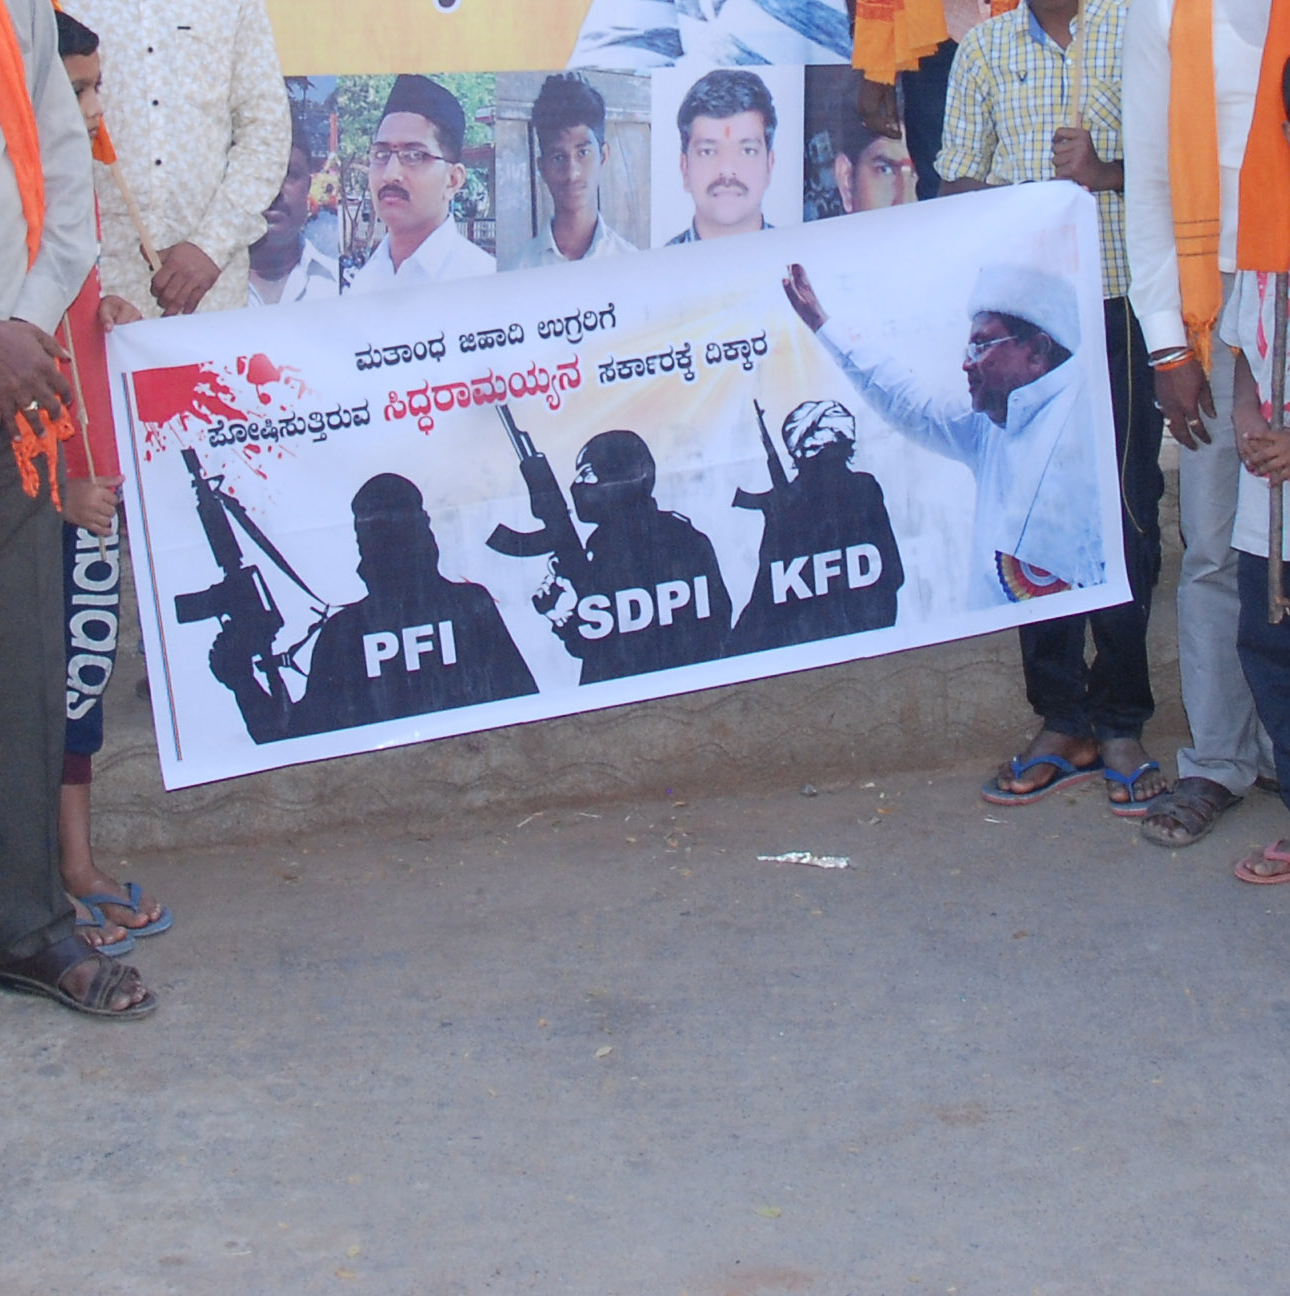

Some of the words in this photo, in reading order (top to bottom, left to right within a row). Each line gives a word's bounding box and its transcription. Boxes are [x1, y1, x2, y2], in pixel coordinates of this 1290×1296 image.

[355, 331, 446, 371] ಮತಾಂಧ
[459, 322, 524, 354] ಜಿಹಾದಿ
[538, 303, 616, 344] ಉಗ್ರರಿಗೆ
[208, 399, 370, 448] ಪೋಷಿಸುತ್ತಿರುವ
[383, 353, 582, 435] ಸಿದ್ಧರಾಮಯ್ಯನ
[598, 342, 694, 383] ಸರ್ಕಾರಕ್ಕೆ
[771, 543, 883, 604] KFD
[577, 575, 711, 640] SDPI
[363, 620, 457, 678] PFI
